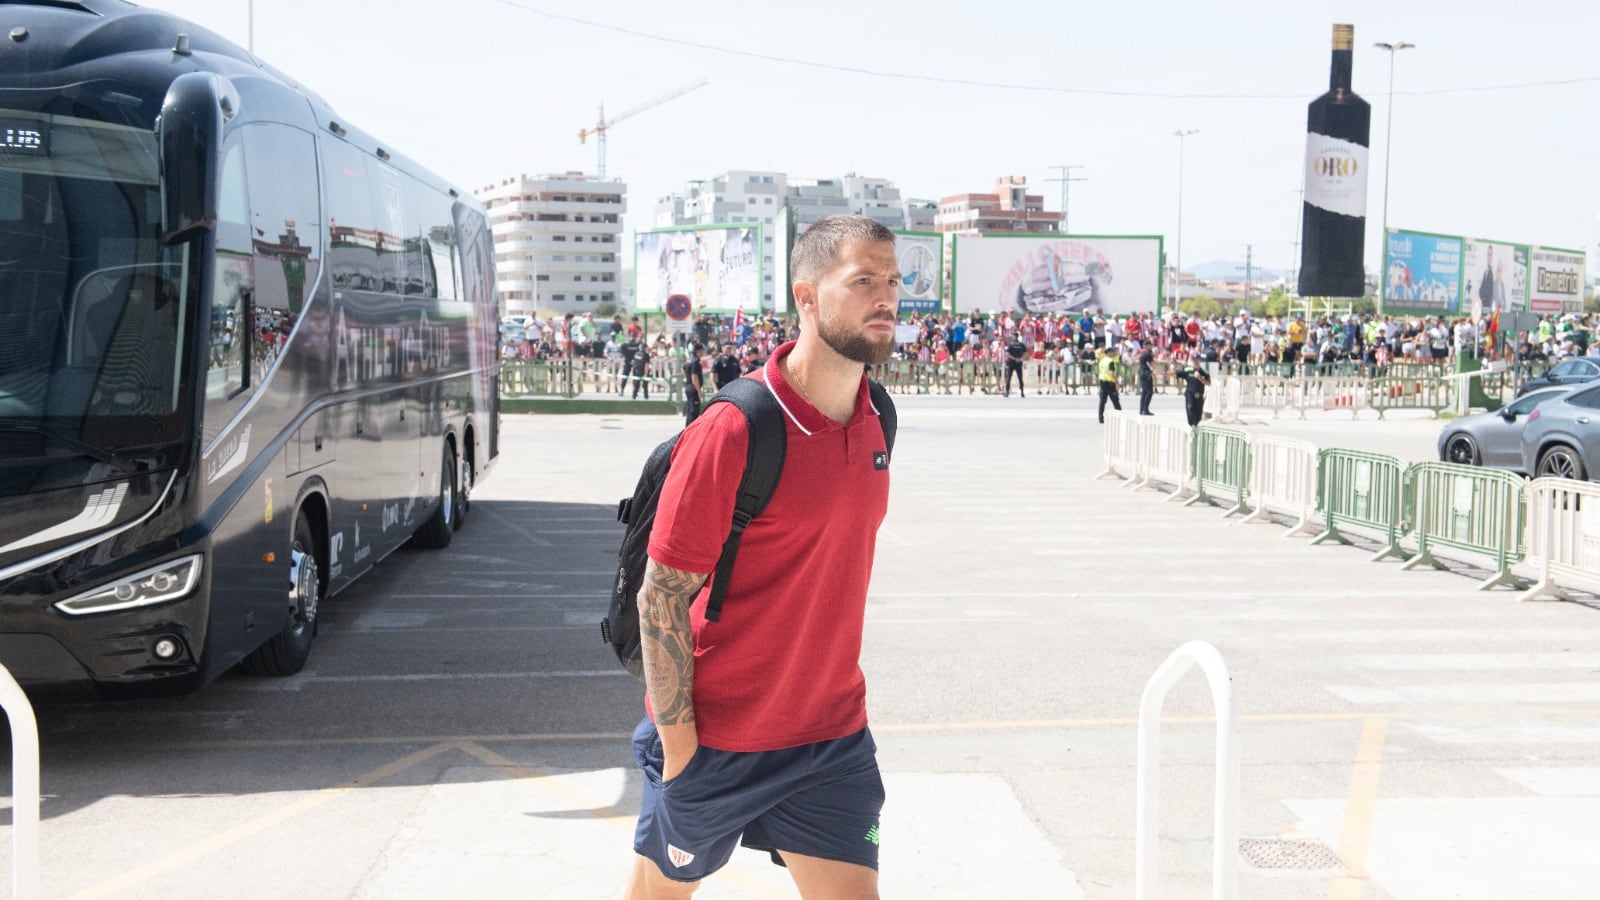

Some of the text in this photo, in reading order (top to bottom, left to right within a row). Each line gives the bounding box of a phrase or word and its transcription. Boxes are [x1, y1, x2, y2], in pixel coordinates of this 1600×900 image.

[1313, 157, 1358, 177] ORO
[333, 305, 450, 388] ATHLETIC CLUB
